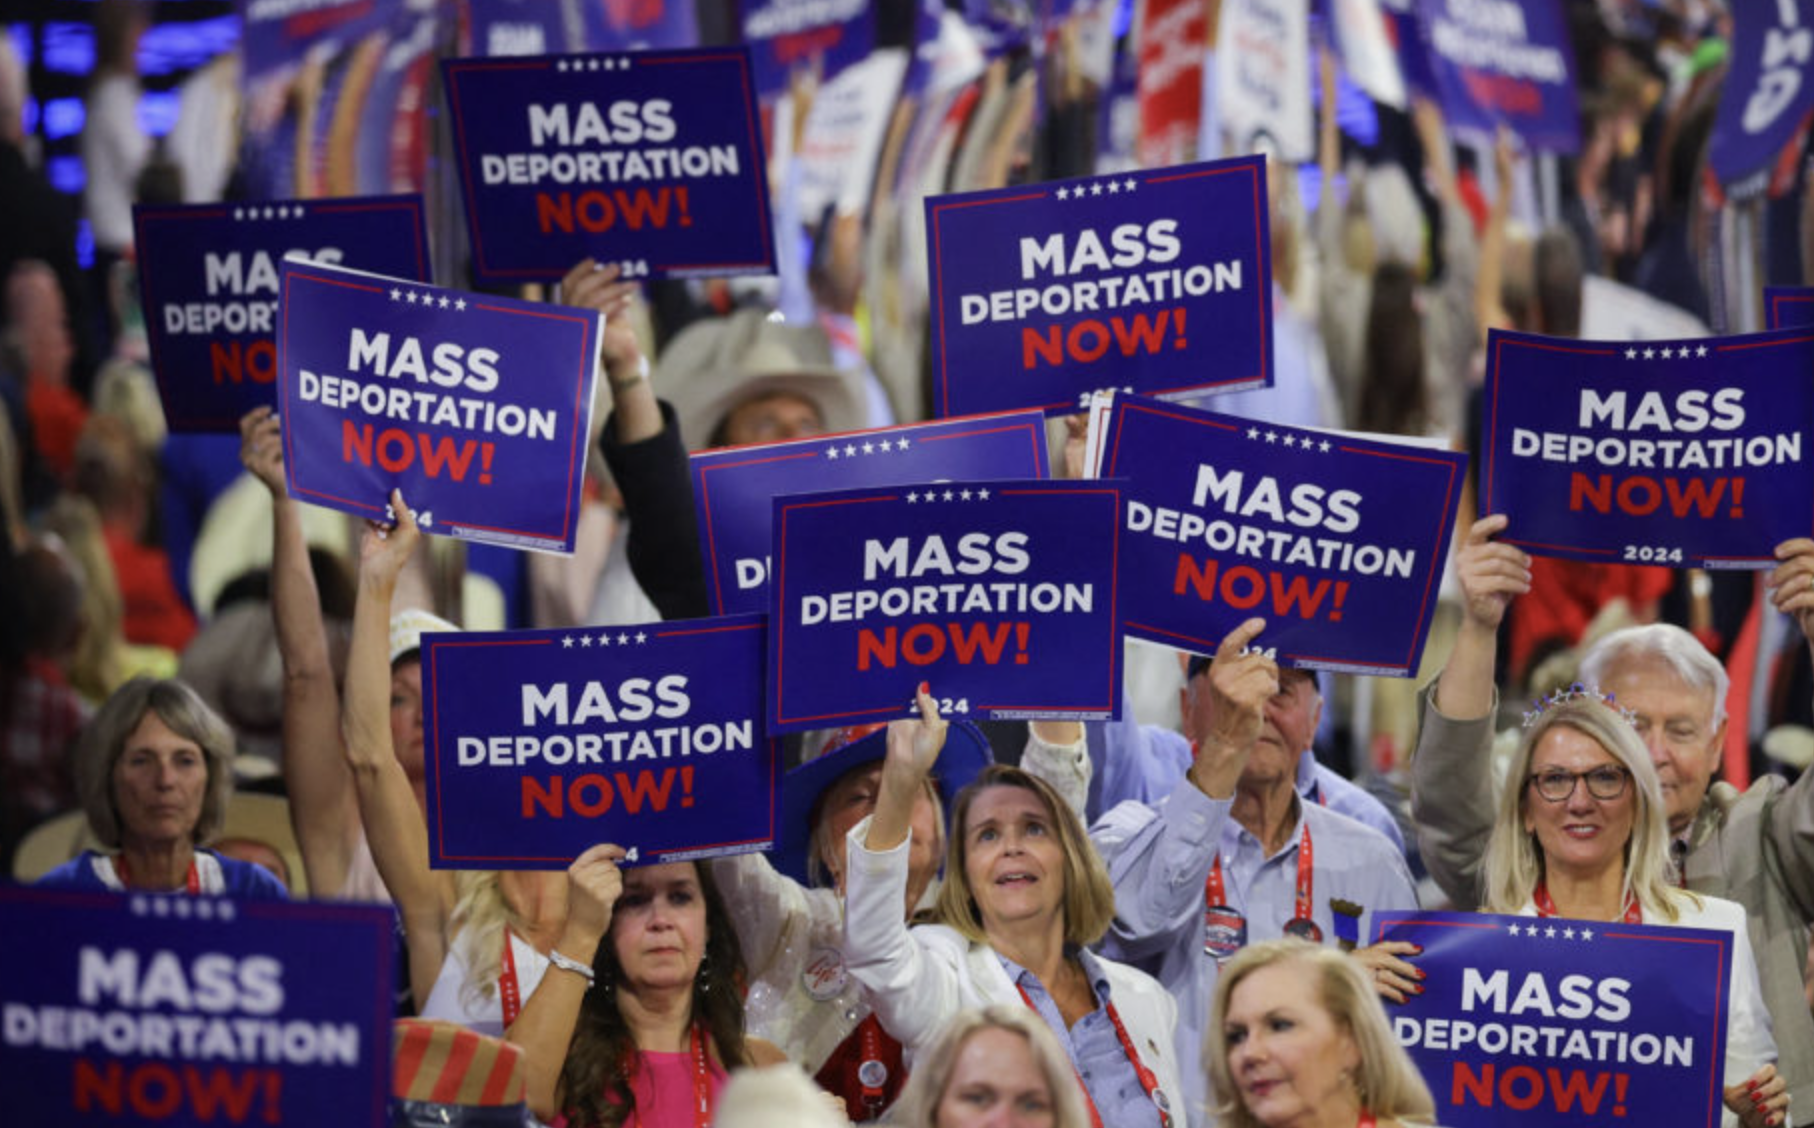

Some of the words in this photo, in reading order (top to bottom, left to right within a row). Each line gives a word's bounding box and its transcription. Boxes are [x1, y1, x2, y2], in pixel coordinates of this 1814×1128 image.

[528, 99, 676, 146] MASS
[482, 145, 739, 184] DEPORTATION
[536, 186, 692, 234] NOW!
[205, 248, 343, 296] MA
[1020, 219, 1181, 280] MASS
[961, 260, 1242, 325] DEPORTATION
[348, 327, 500, 393] MASS
[1022, 307, 1187, 370] NOW!
[299, 370, 557, 440] DEPORTATION
[1579, 387, 1746, 432] MASS
[342, 419, 495, 485] NOW!
[1511, 427, 1801, 469] DEPORTATION
[1192, 463, 1363, 533] MASS
[1569, 471, 1746, 519] NOW!
[863, 531, 1031, 581] MASS
[1127, 500, 1416, 578] DEPORTATION
[1623, 545, 1683, 562] 2024
[801, 582, 1093, 626] DEPORTATION
[1173, 552, 1350, 622] NOW!
[857, 621, 1031, 671] NOW!
[521, 674, 691, 726] MASS
[457, 719, 753, 766] DEPORTATION
[521, 765, 695, 819] NOW!
[78, 946, 285, 1016] MASS
[1461, 967, 1632, 1023] MASS
[2, 1003, 360, 1066] DEPORTATION
[1392, 1016, 1694, 1067] DEPORTATION
[72, 1057, 282, 1124] NOW!
[1451, 1060, 1631, 1118] NOW!
